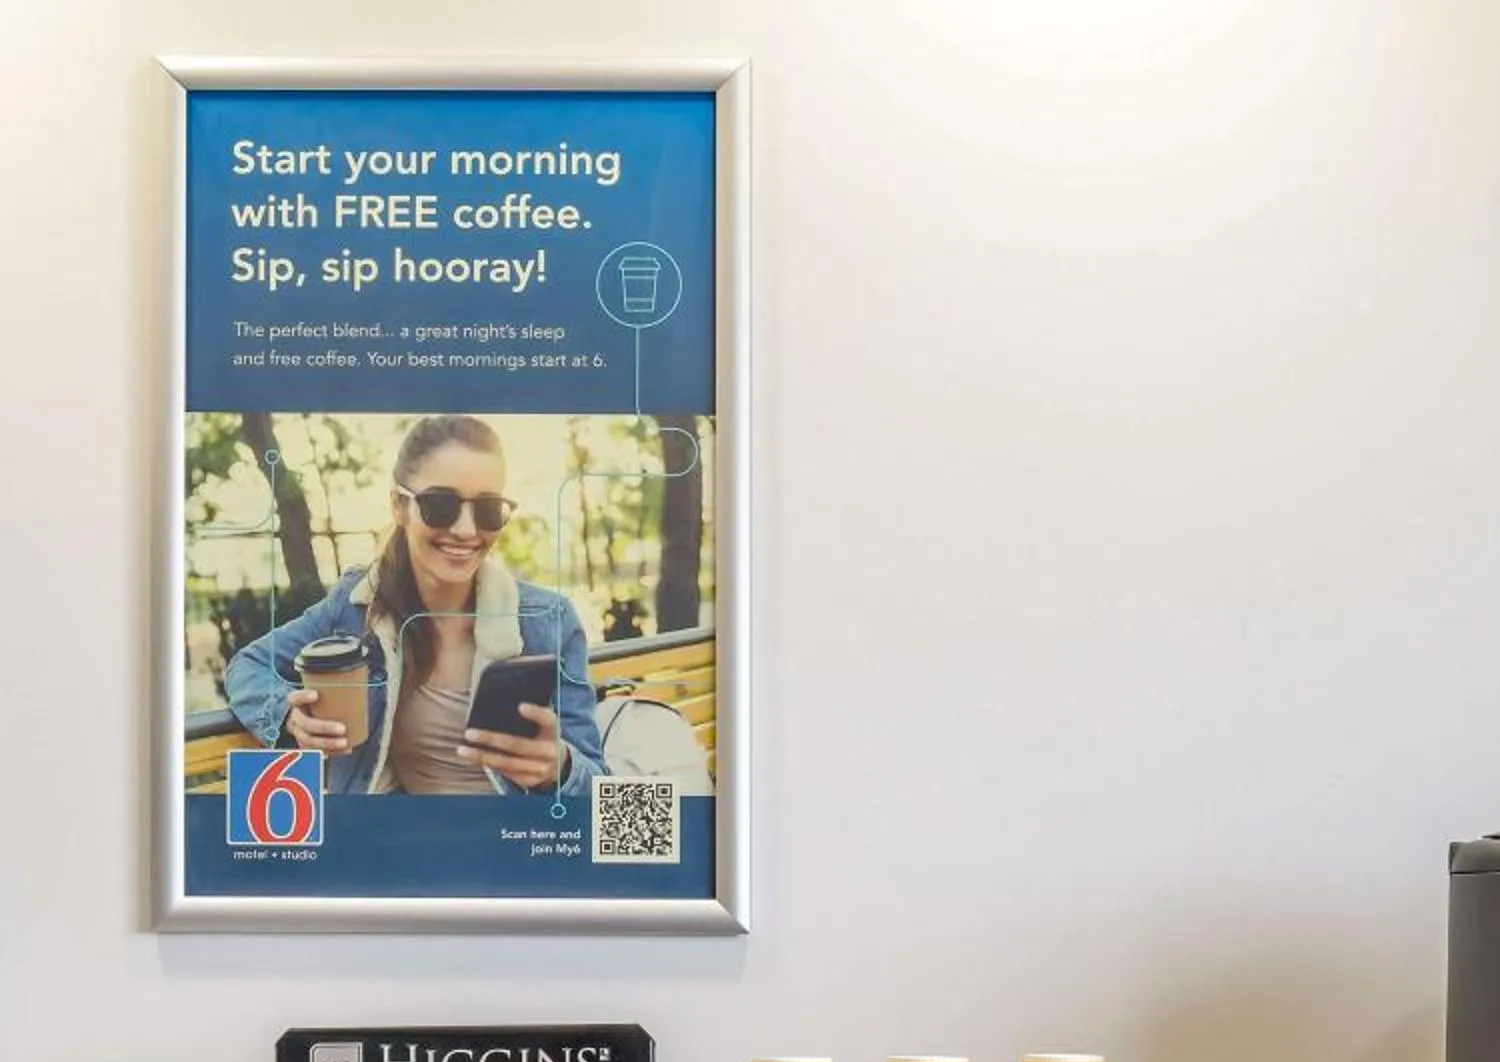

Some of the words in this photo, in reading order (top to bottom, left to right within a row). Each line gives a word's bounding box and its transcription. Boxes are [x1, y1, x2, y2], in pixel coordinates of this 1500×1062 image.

[232, 140, 332, 175] Start
[344, 151, 437, 185] your
[451, 142, 621, 186] morning
[231, 192, 318, 228] with
[335, 195, 438, 229] FREE
[453, 193, 592, 229] coffee.
[231, 247, 306, 292] Sip,
[321, 248, 379, 292] sip
[394, 247, 546, 293] hooray!
[233, 321, 265, 337] The
[269, 321, 328, 343] perfect
[333, 321, 395, 338] blend...
[399, 327, 410, 338] a
[415, 325, 459, 343] great
[463, 323, 517, 343] night's
[520, 323, 565, 343] sleep
[233, 351, 265, 366] and
[269, 349, 302, 366] free
[305, 349, 361, 367] coffee.
[366, 351, 405, 367] Your
[407, 351, 444, 367] best
[448, 351, 527, 372] mornings
[531, 354, 567, 367] start
[571, 354, 588, 367] at
[592, 352, 607, 368] 6.
[246, 750, 315, 844] 6
[559, 828, 582, 839] and
[281, 849, 318, 860] studio
